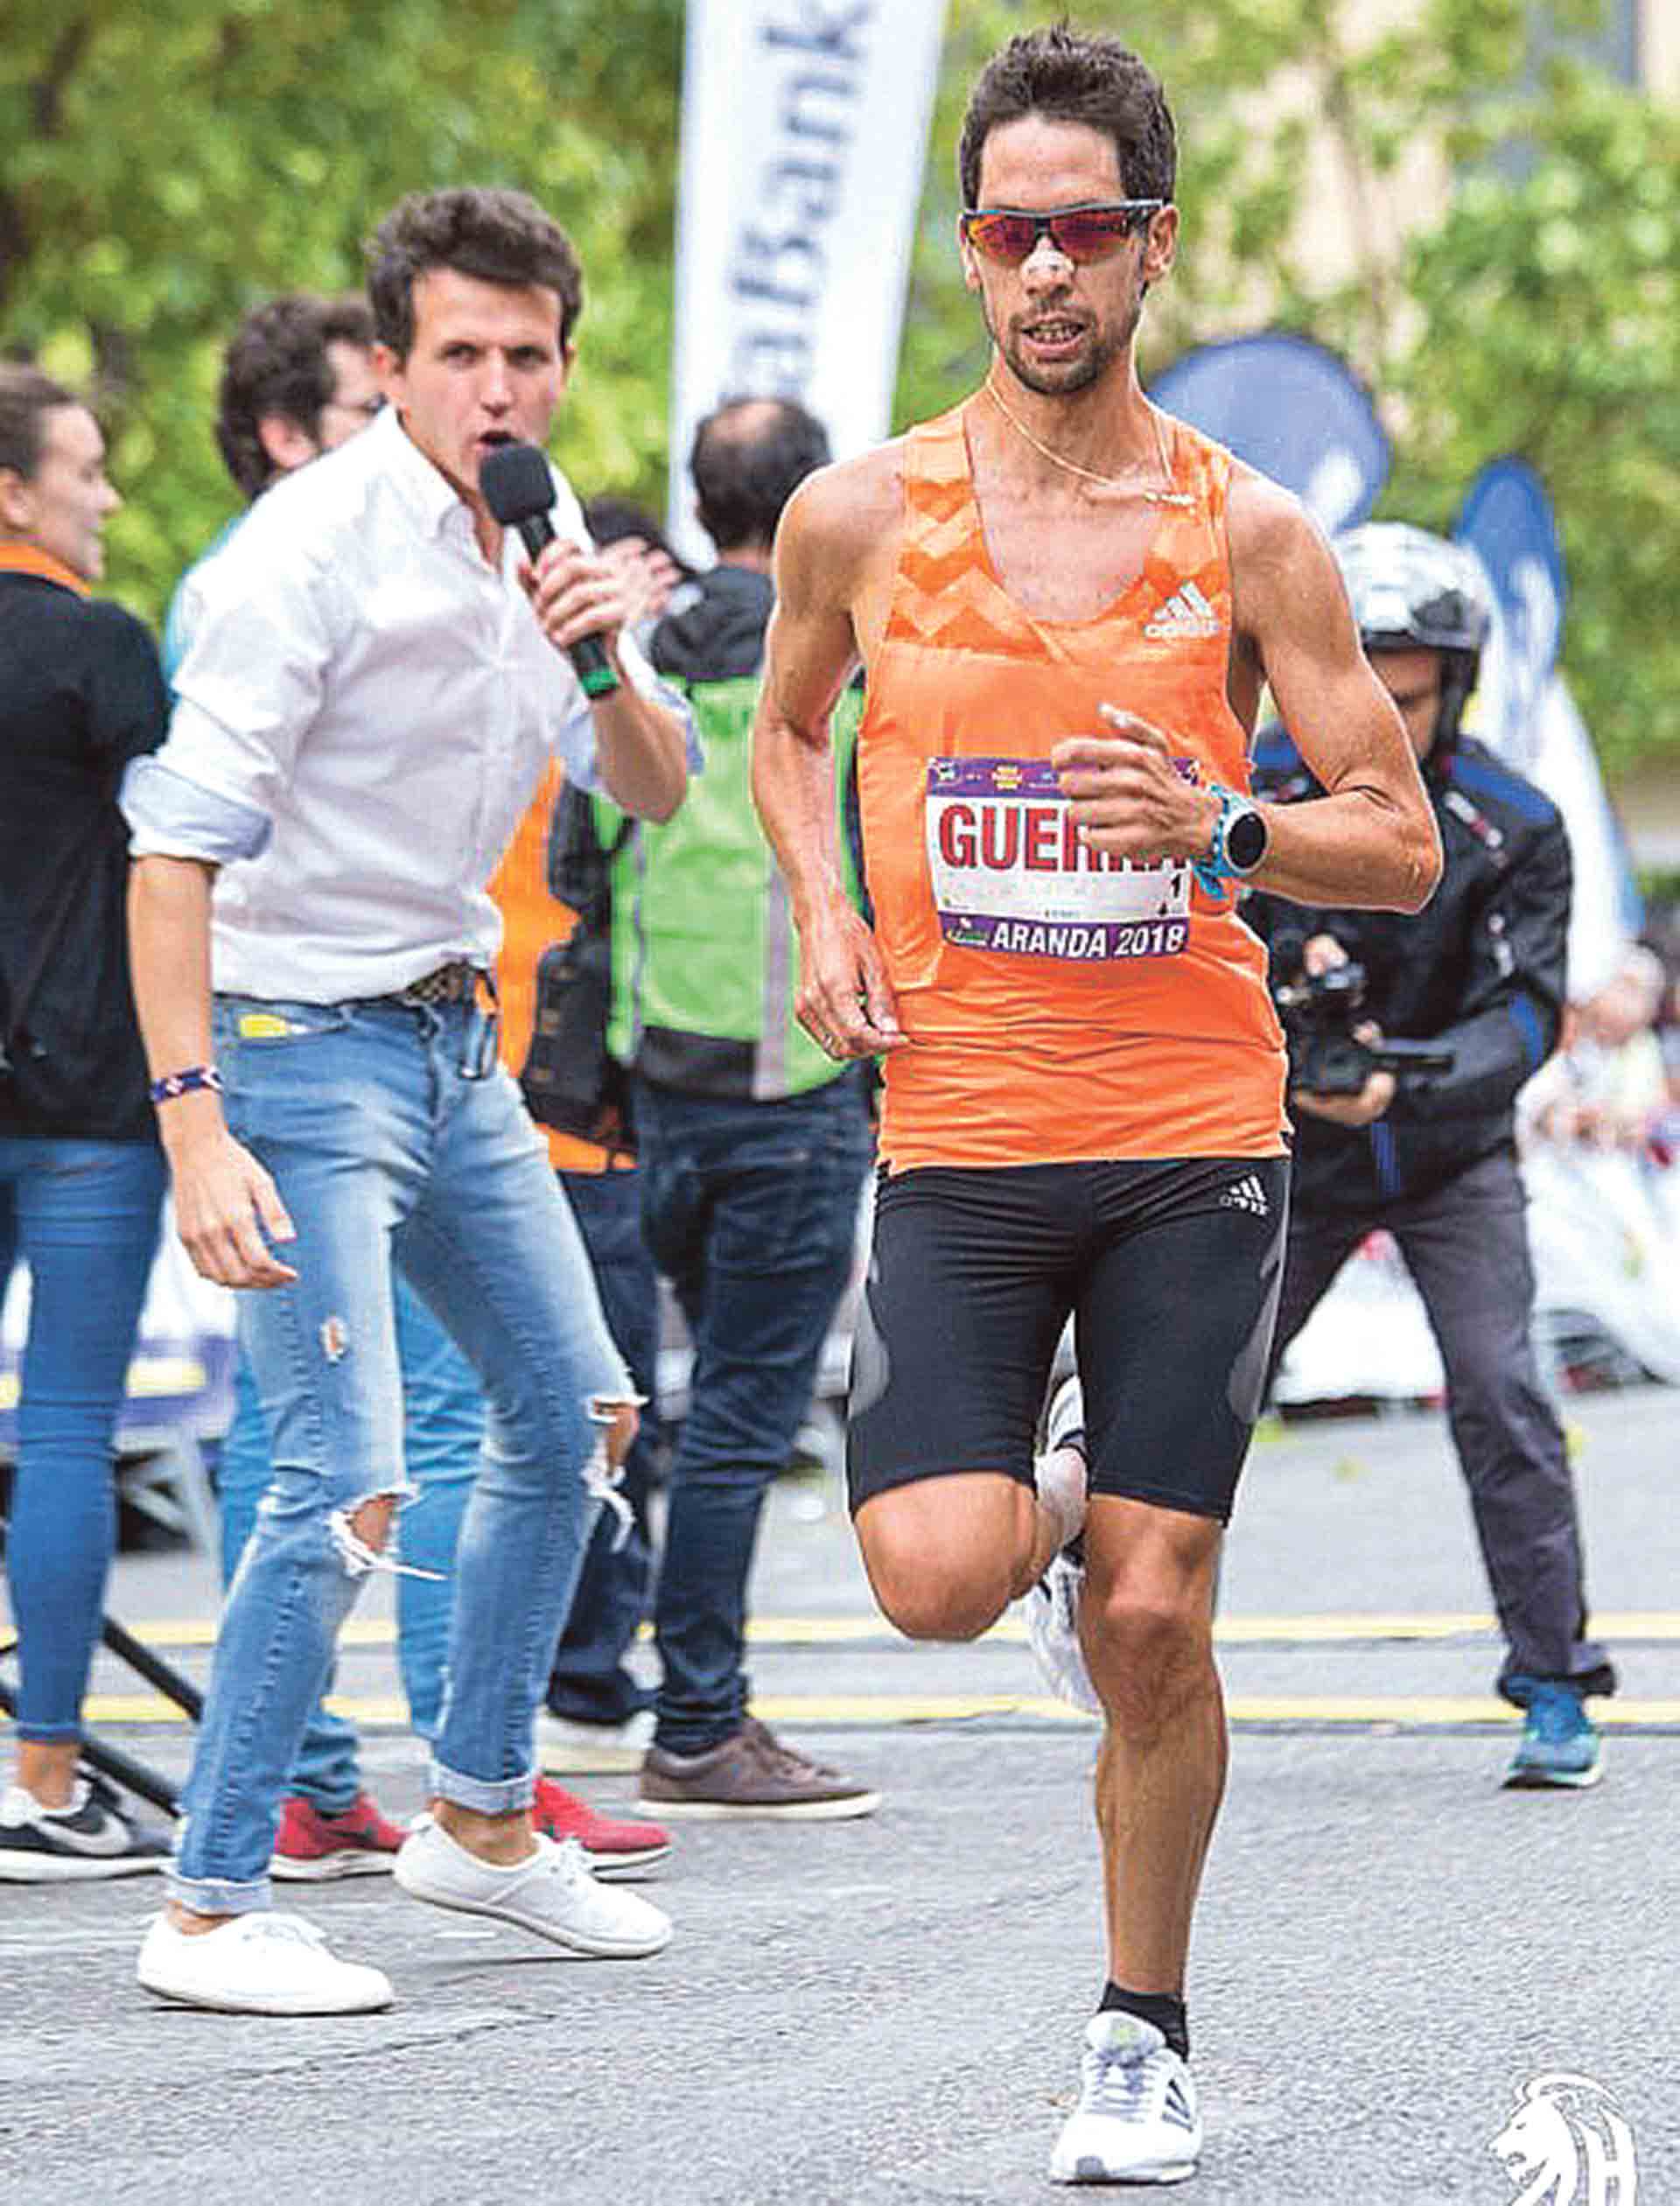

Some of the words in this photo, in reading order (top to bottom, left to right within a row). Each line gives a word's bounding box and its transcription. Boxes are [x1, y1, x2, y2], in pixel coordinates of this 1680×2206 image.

[719, 0, 873, 403] aBank
[939, 804, 1187, 872] GUER
[1171, 873, 1181, 899] 1
[991, 921, 1107, 958] ARANDA
[1114, 924, 1186, 956] 2018
